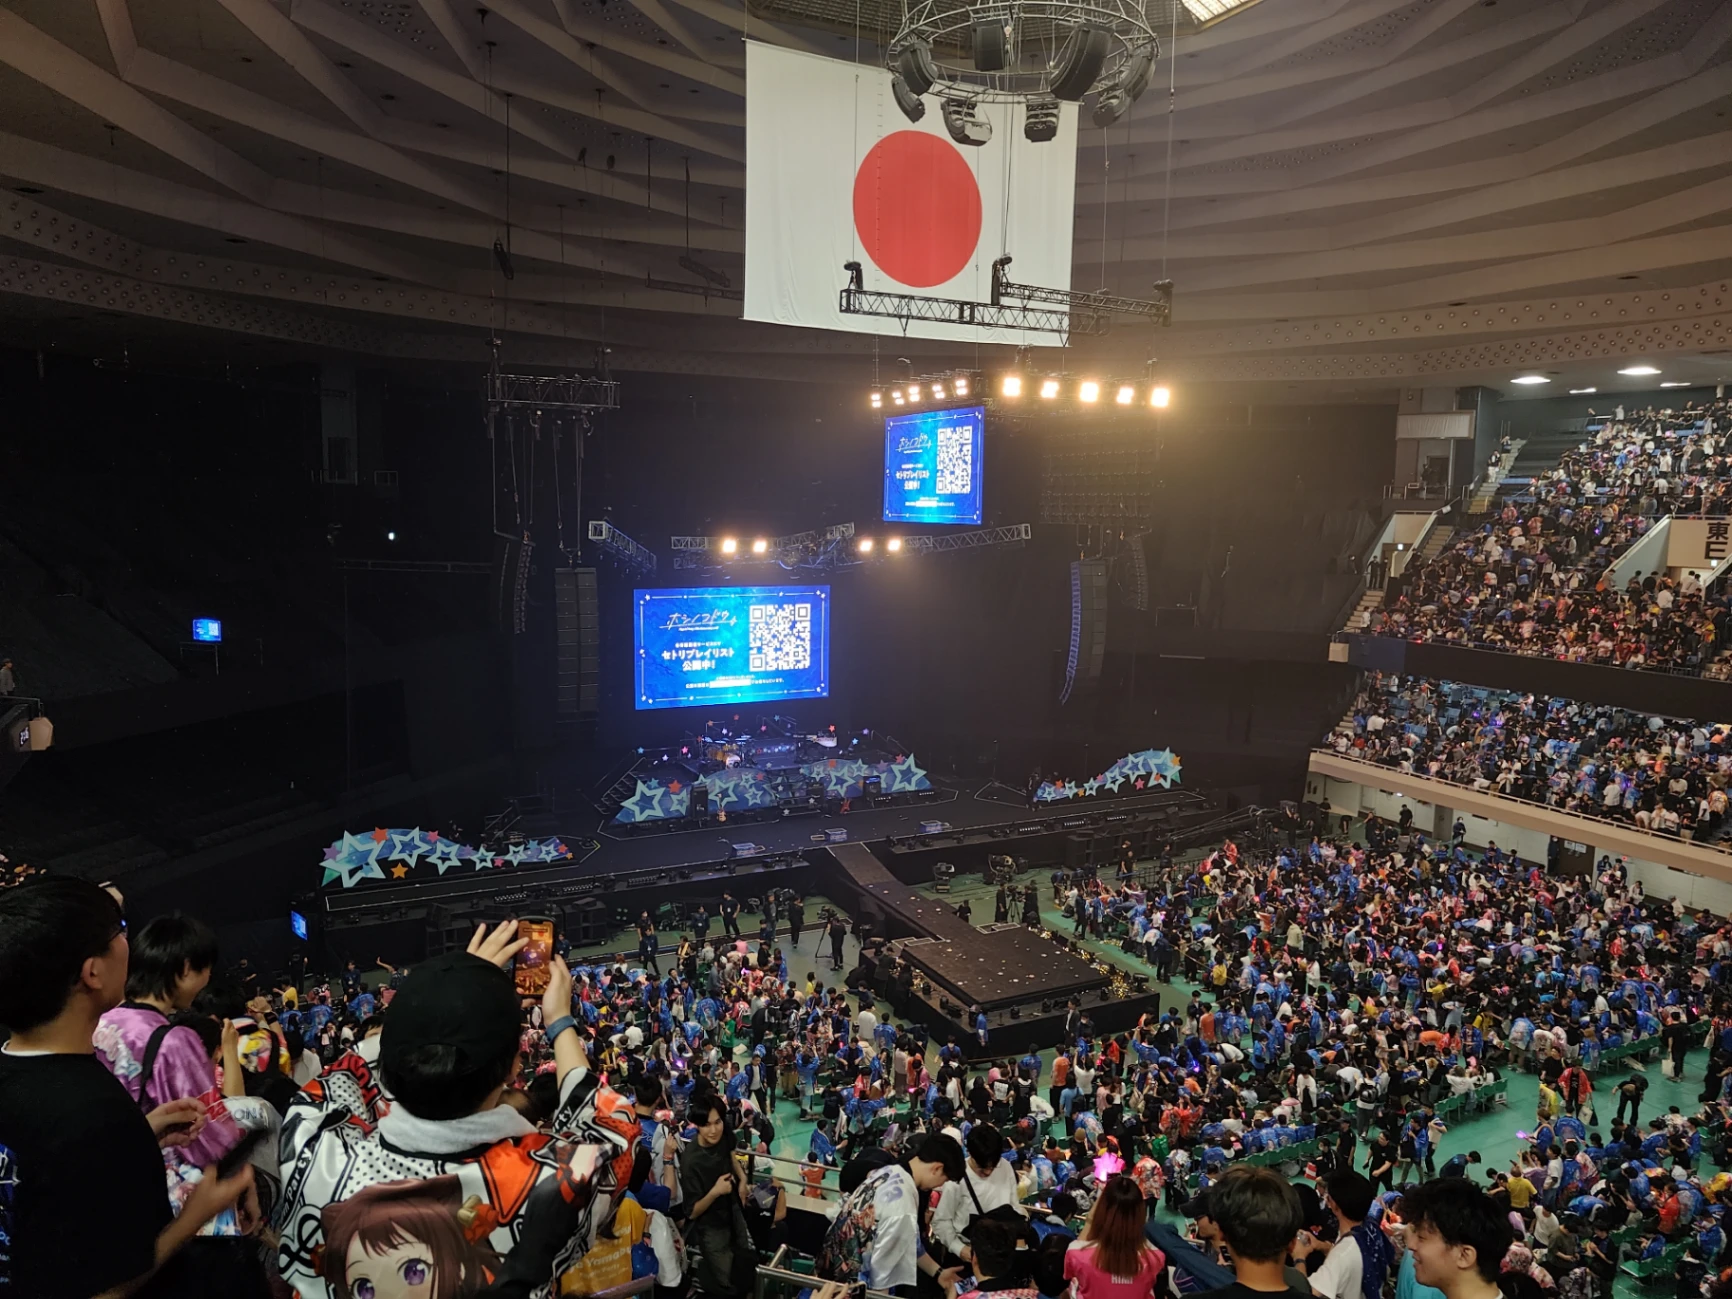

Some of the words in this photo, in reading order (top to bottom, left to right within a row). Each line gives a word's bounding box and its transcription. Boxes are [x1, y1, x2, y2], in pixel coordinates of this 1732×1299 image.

[661, 647, 735, 660] セトリプレイリスト
